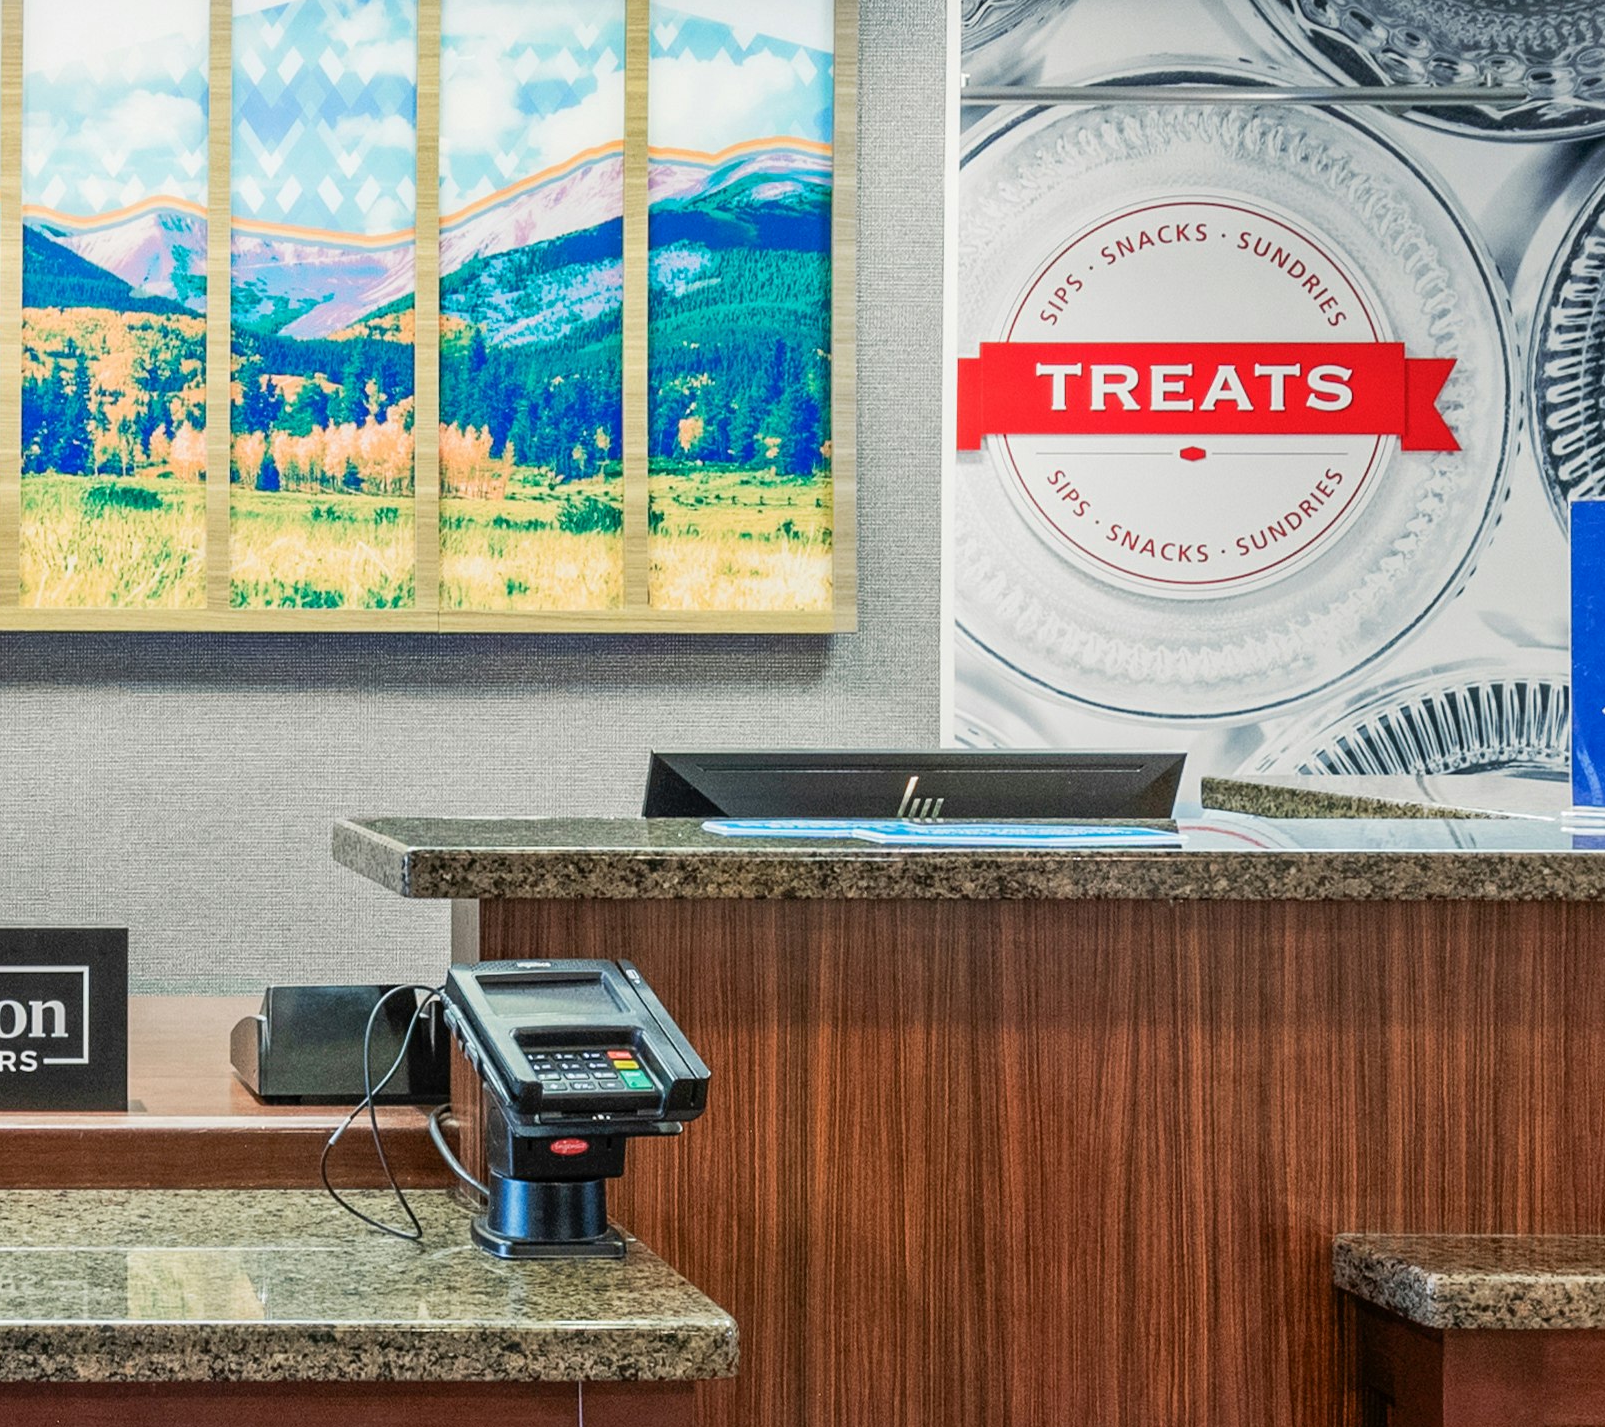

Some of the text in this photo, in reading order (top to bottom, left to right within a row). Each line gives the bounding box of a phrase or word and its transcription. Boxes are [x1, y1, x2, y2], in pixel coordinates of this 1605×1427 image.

[1040, 222, 1348, 328] SIPS SNACKS SUNDRIES
[1035, 362, 1355, 413] TREATS
[1047, 467, 1344, 563] SIPS SNACKS SUNDRIES
